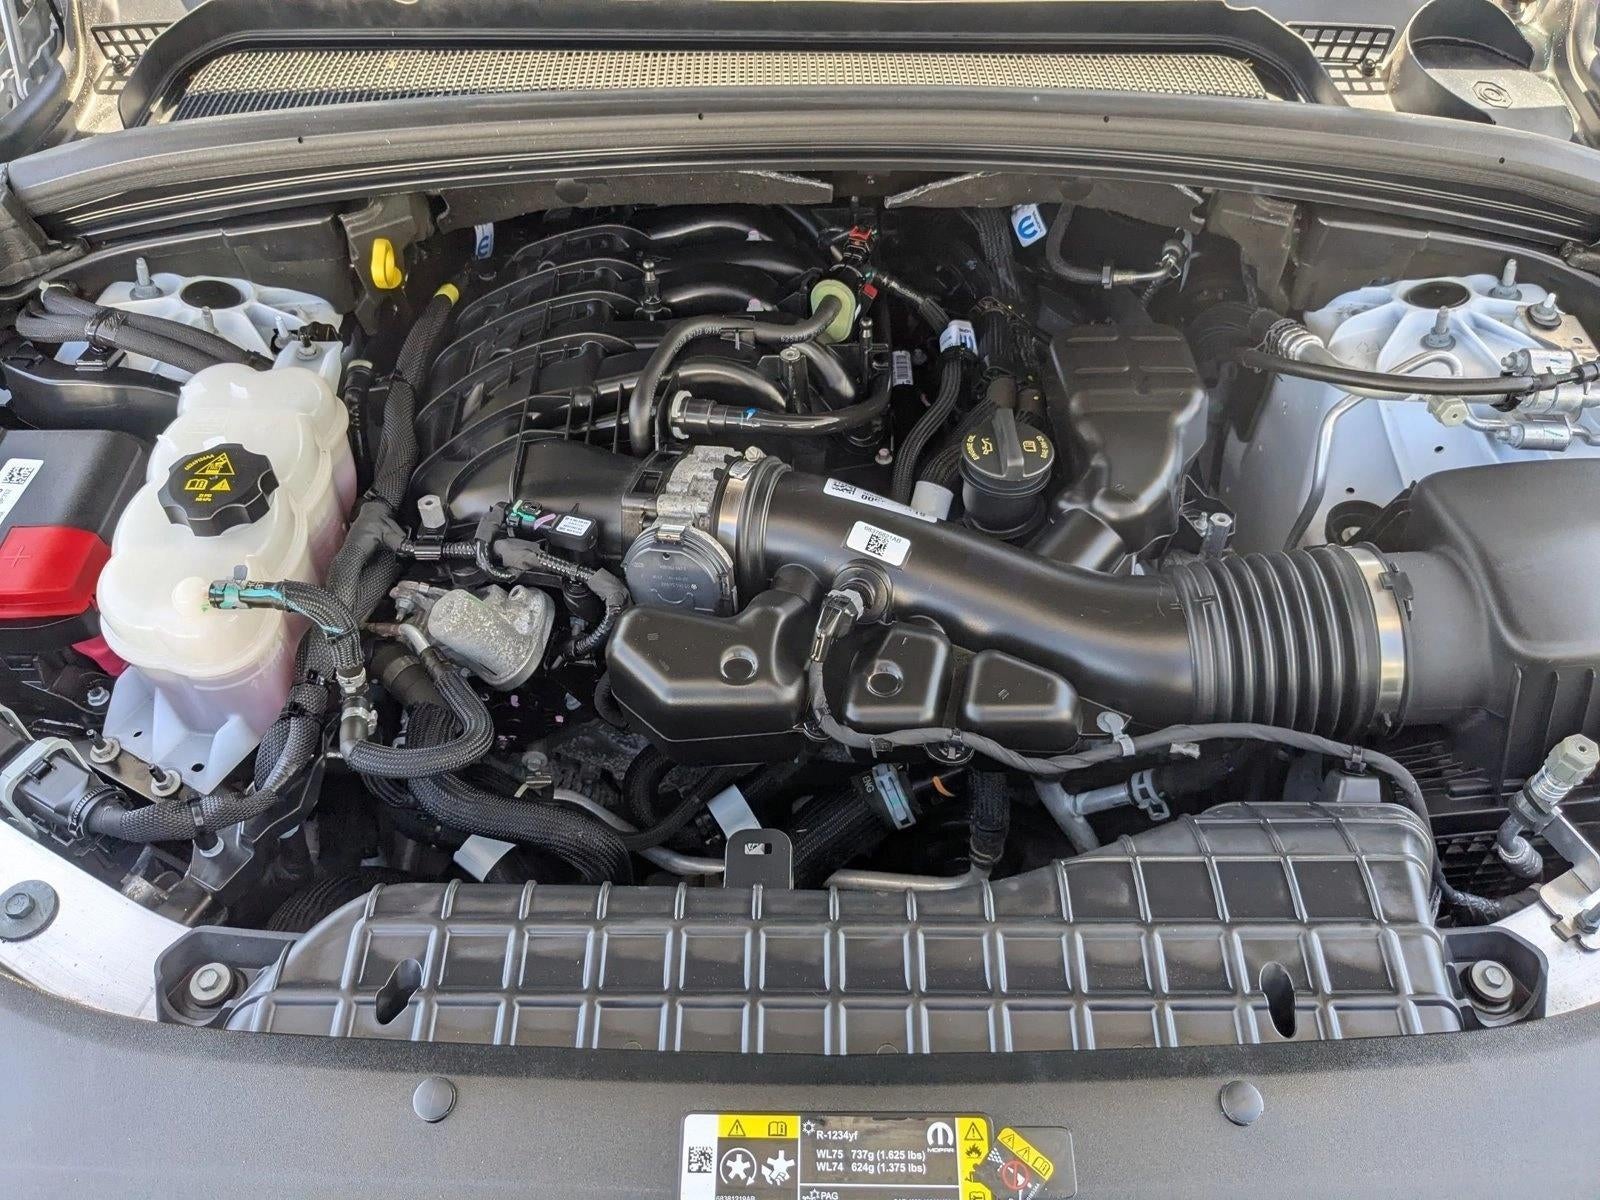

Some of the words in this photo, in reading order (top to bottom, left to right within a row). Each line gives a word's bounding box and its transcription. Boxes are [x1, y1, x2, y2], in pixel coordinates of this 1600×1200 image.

[863, 776, 875, 793] ENG
[816, 1130, 858, 1142] R-1234yf
[816, 1149, 844, 1159] WL75
[851, 1149, 875, 1161] 737g
[876, 1149, 906, 1161] (1.625
[907, 1150, 927, 1161] lbs)
[816, 1161, 844, 1172] WL74
[851, 1162, 875, 1174] 624g
[876, 1162, 906, 1174] (1.375
[907, 1162, 927, 1174] lbs)
[820, 1191, 839, 1200] PAG
